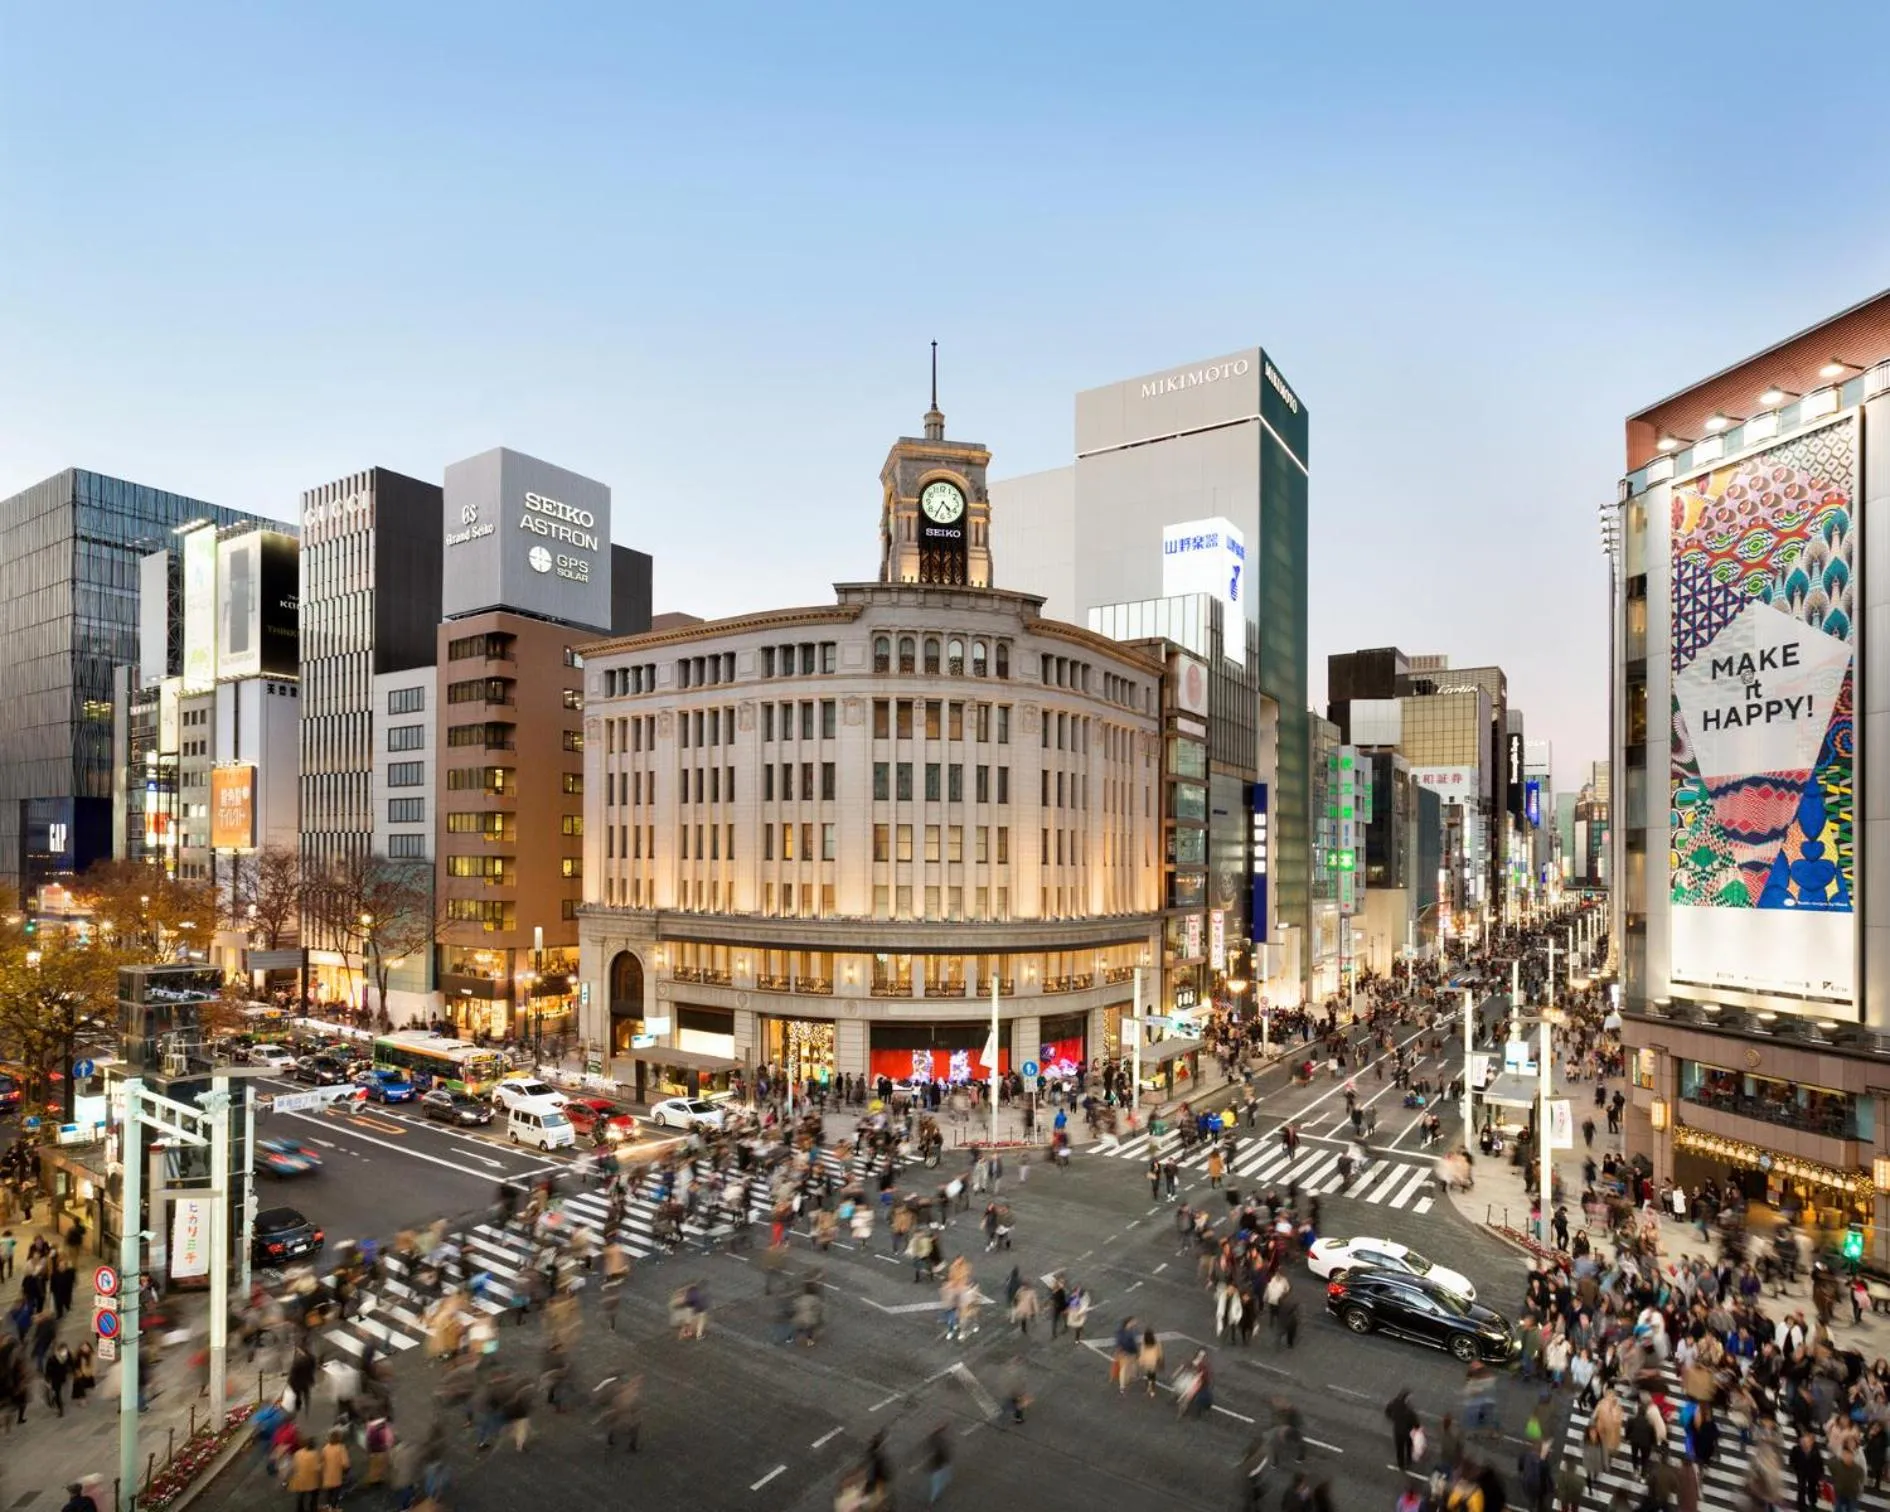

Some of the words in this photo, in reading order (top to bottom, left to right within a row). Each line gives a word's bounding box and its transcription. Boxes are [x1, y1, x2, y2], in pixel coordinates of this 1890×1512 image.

[1141, 359, 1249, 399] MIKIMOTO
[1264, 360, 1298, 415] MIKIMOTO
[304, 490, 371, 527] GUCCI
[461, 503, 479, 525] GS
[524, 491, 594, 529] SEIKO
[446, 530, 470, 547] Grand
[471, 523, 495, 540] Seiko
[519, 515, 599, 552] ASTRON
[925, 527, 961, 538] SEIKO
[556, 554, 590, 574] GPS
[556, 567, 590, 584] SOLAR
[1711, 642, 1800, 680] MAKE
[1702, 694, 1814, 732] HAPPY!
[49, 823, 67, 852] GAP
